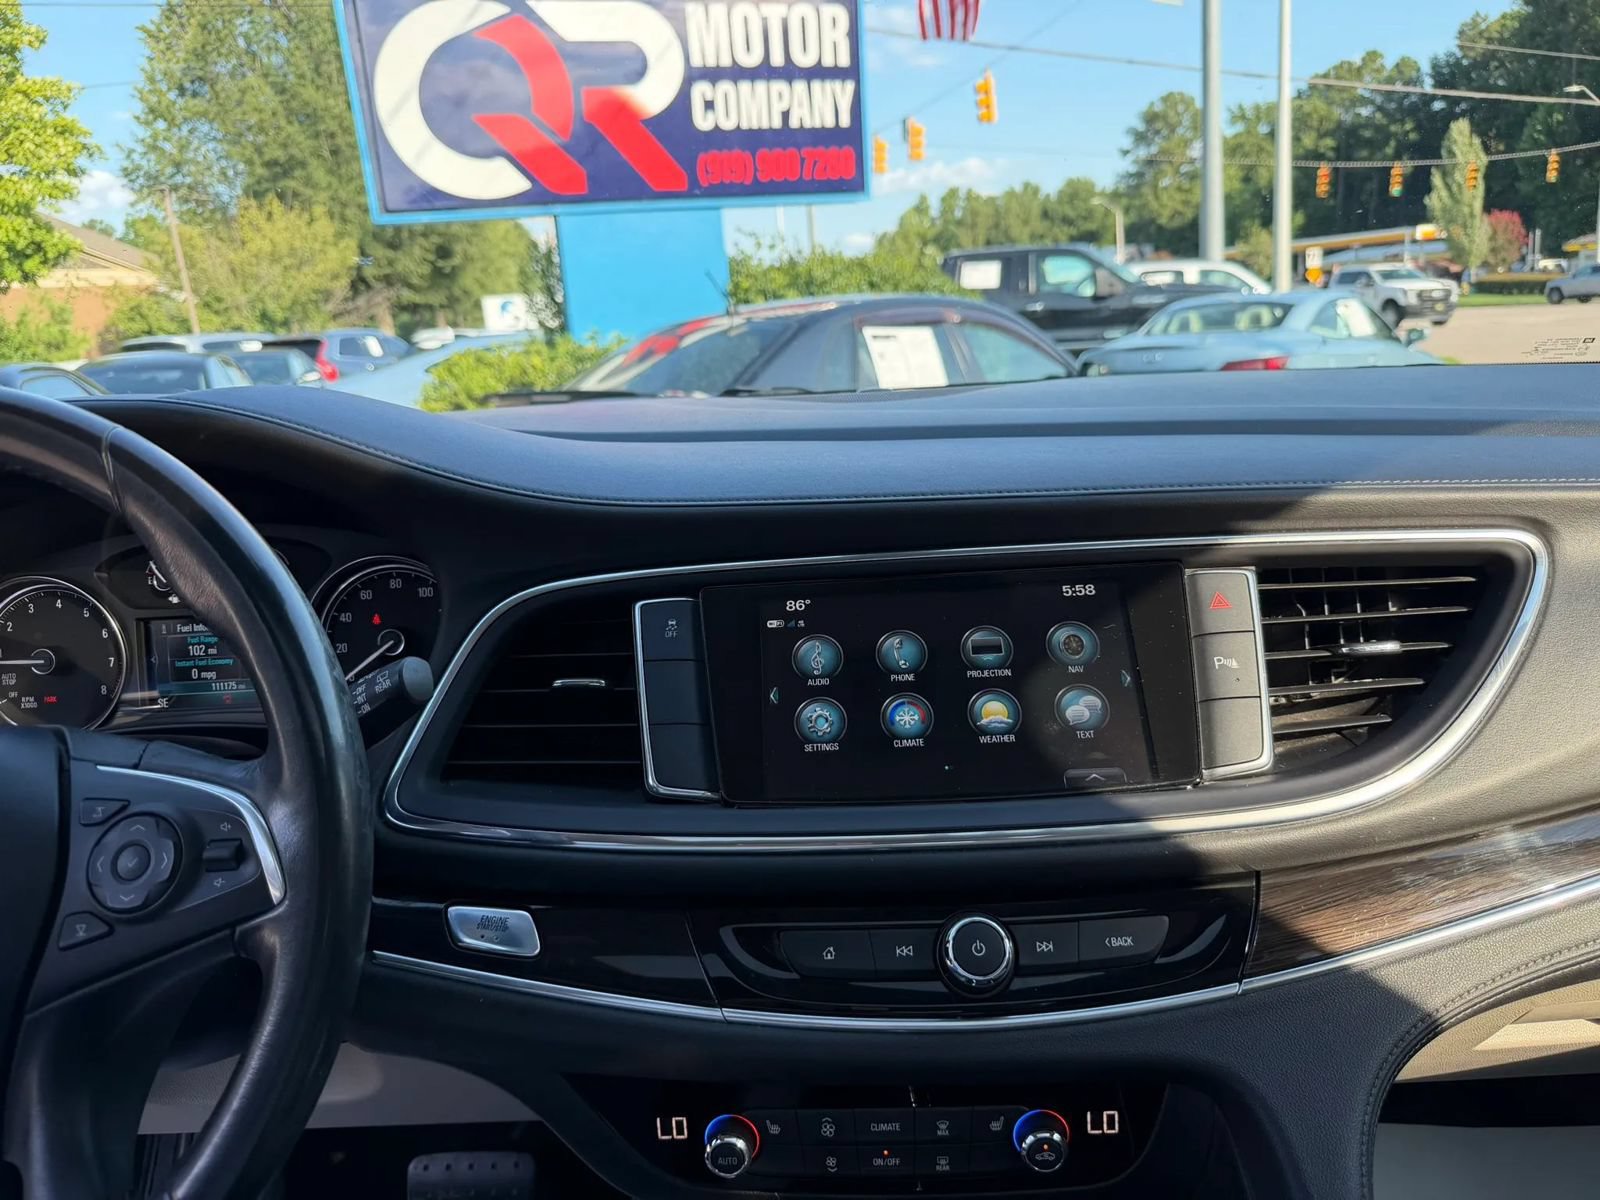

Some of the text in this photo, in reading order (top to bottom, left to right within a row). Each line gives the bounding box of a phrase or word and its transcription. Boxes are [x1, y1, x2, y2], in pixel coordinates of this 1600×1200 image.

[685, 2, 851, 68] MOTOR
[690, 79, 855, 131] COMPANY
[390, 578, 402, 589] 80
[360, 590, 373, 600] 60
[418, 587, 433, 597] 100
[1062, 584, 1096, 597] 5:58
[28, 604, 34, 613] 3
[56, 599, 62, 608] 4
[786, 599, 811, 611] 86°
[82, 608, 90, 617] 5
[339, 612, 352, 622] 40
[6, 621, 13, 632] 2
[177, 624, 192, 632] Fuel
[102, 628, 109, 638] 6
[188, 645, 217, 656] 102 mi
[336, 643, 348, 653] 20
[108, 657, 115, 667] 7
[208, 658, 233, 666] Economy
[191, 668, 217, 679] 0 mpg
[967, 668, 1012, 678] PROJECTION
[1068, 665, 1084, 674] NAV
[807, 676, 830, 686] AUDIO
[890, 673, 915, 683] PHONE
[101, 685, 107, 695] 8
[211, 682, 237, 690] 111175
[375, 679, 392, 694] REAR
[158, 698, 169, 708] SE
[978, 734, 1016, 744] WEATHER
[1076, 729, 1095, 739] TEXT
[804, 742, 839, 752] SETTINGS
[893, 738, 925, 748] CLIMATE
[480, 914, 510, 927] ENGINE
[1111, 936, 1134, 947] BACK
[870, 1122, 901, 1131] CLIMATE
[1087, 1110, 1119, 1134] LO
[656, 1117, 688, 1139] LO
[718, 1157, 738, 1165] AUTO
[872, 1158, 901, 1166] ON/OFF
